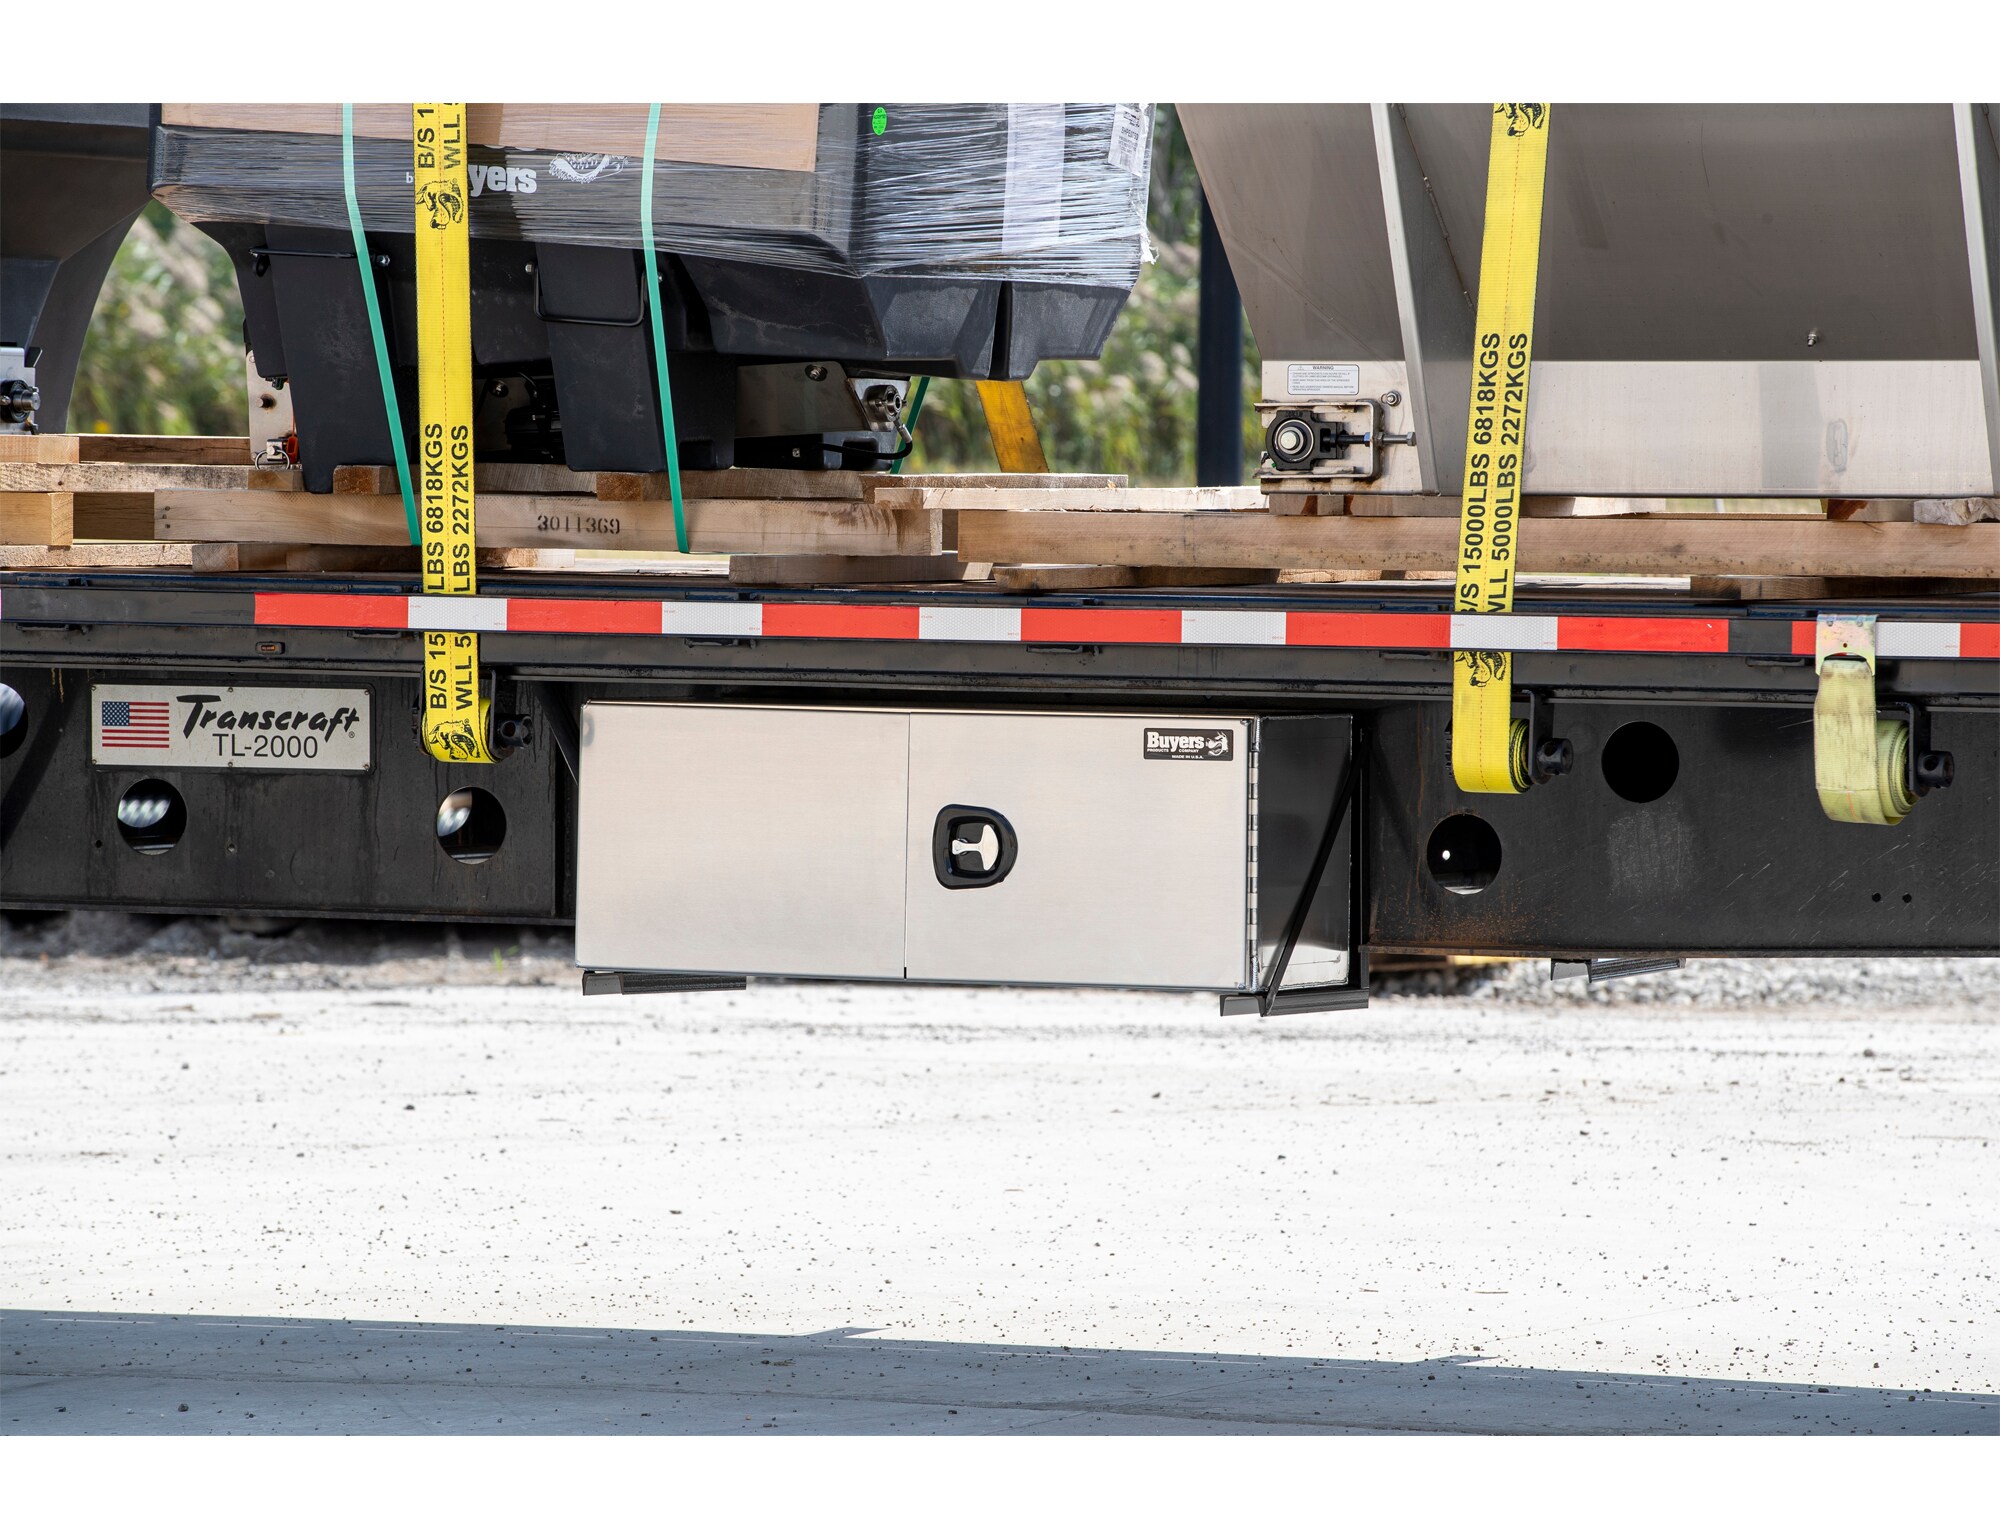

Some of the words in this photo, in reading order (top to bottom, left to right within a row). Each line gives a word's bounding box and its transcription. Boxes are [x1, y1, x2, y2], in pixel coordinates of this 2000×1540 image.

[417, 103, 434, 118] 1
[417, 127, 435, 168] B/S
[443, 114, 461, 170] WLL
[468, 164, 537, 197] yers
[1473, 332, 1501, 445] 6818KGS
[1500, 333, 1528, 446] 2272KGS
[424, 423, 445, 533] 6818KGS
[450, 425, 470, 536] 2272KGS
[537, 514, 621, 535] 3011369
[1462, 453, 1490, 574] 15000LBS
[1491, 453, 1518, 562] 5000LBS
[426, 541, 445, 592] LBS
[1459, 583, 1480, 612] /S
[454, 633, 472, 648] 5
[428, 669, 447, 709] B/S
[454, 655, 473, 711] WLL
[176, 694, 360, 743] Transcraft
[1147, 731, 1205, 752] Buyers
[212, 733, 319, 758] TL-2000
